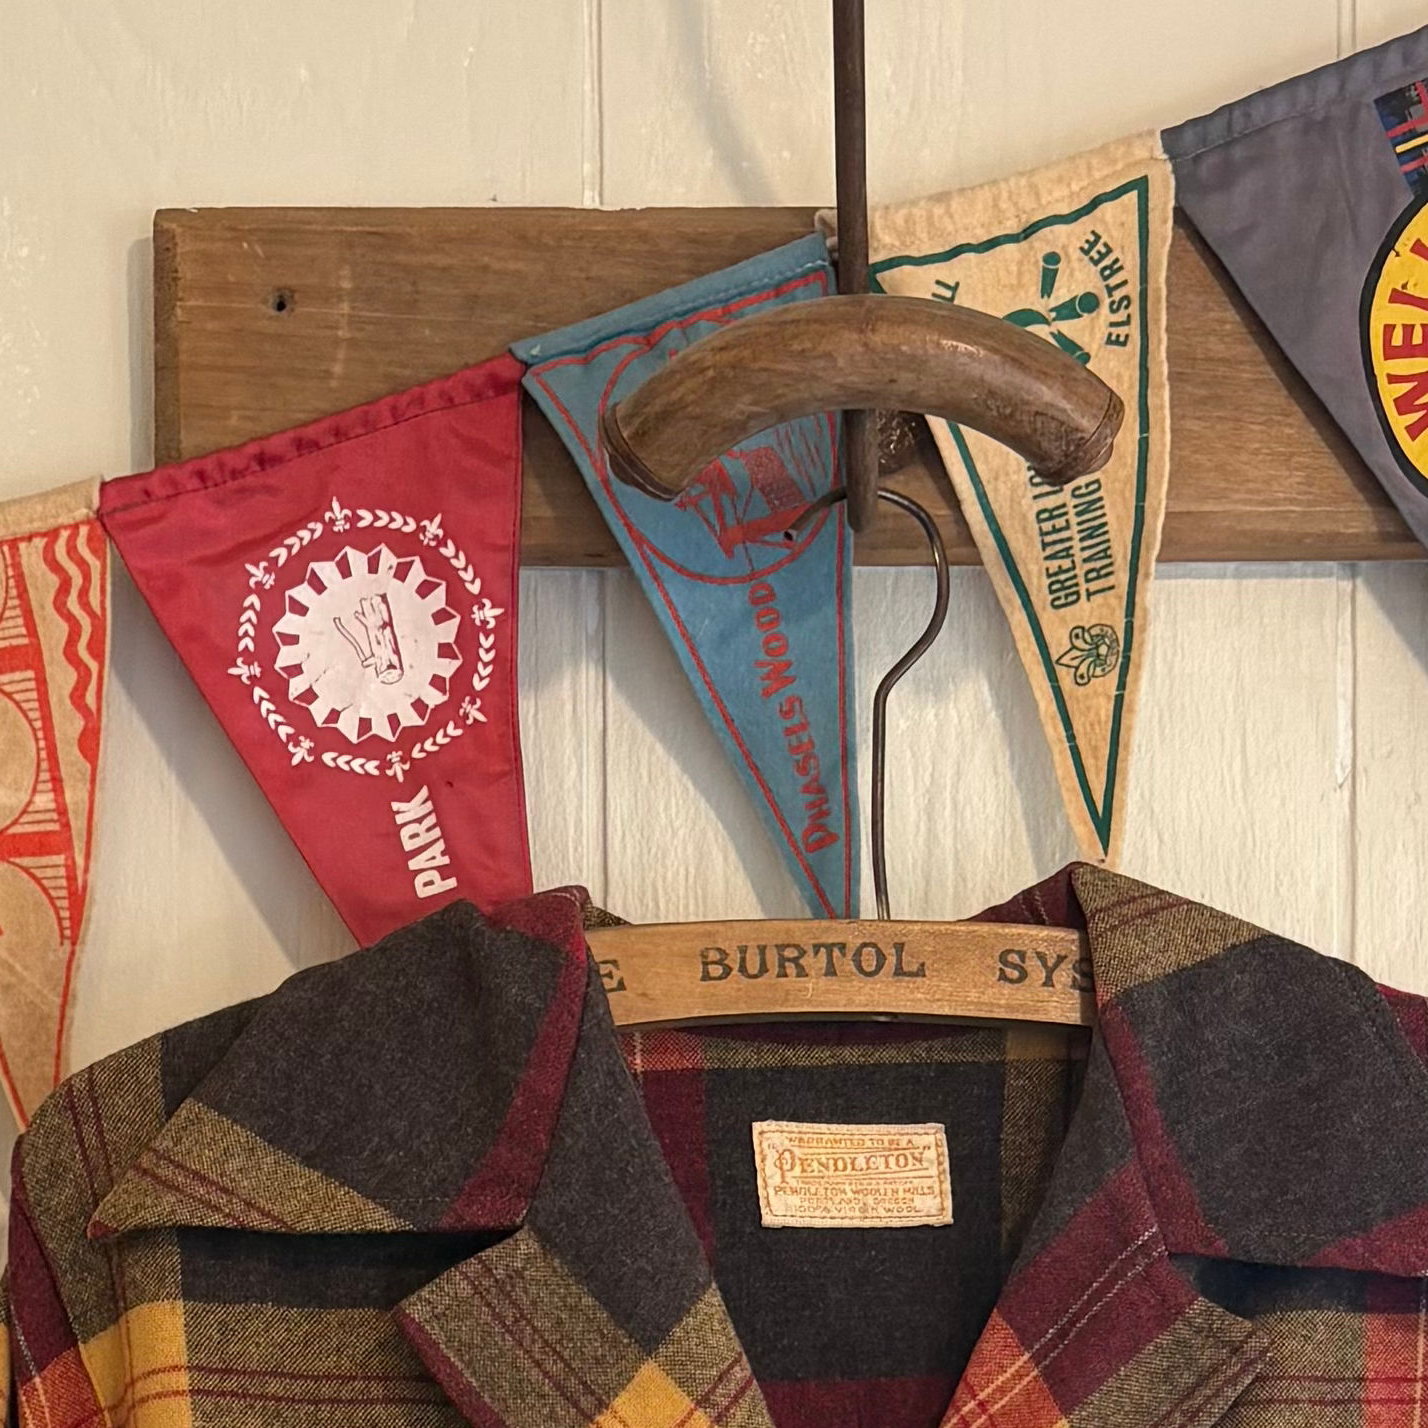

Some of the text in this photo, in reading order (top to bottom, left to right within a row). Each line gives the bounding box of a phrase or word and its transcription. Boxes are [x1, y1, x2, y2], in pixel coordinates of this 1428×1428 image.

[1079, 230, 1132, 347] ELSTREE
[1035, 502, 1081, 611] GREATER
[1071, 478, 1115, 603] TRAINING
[748, 581, 797, 700] WOOD
[390, 785, 458, 899] PARK
[699, 941, 926, 982] BURTOL
